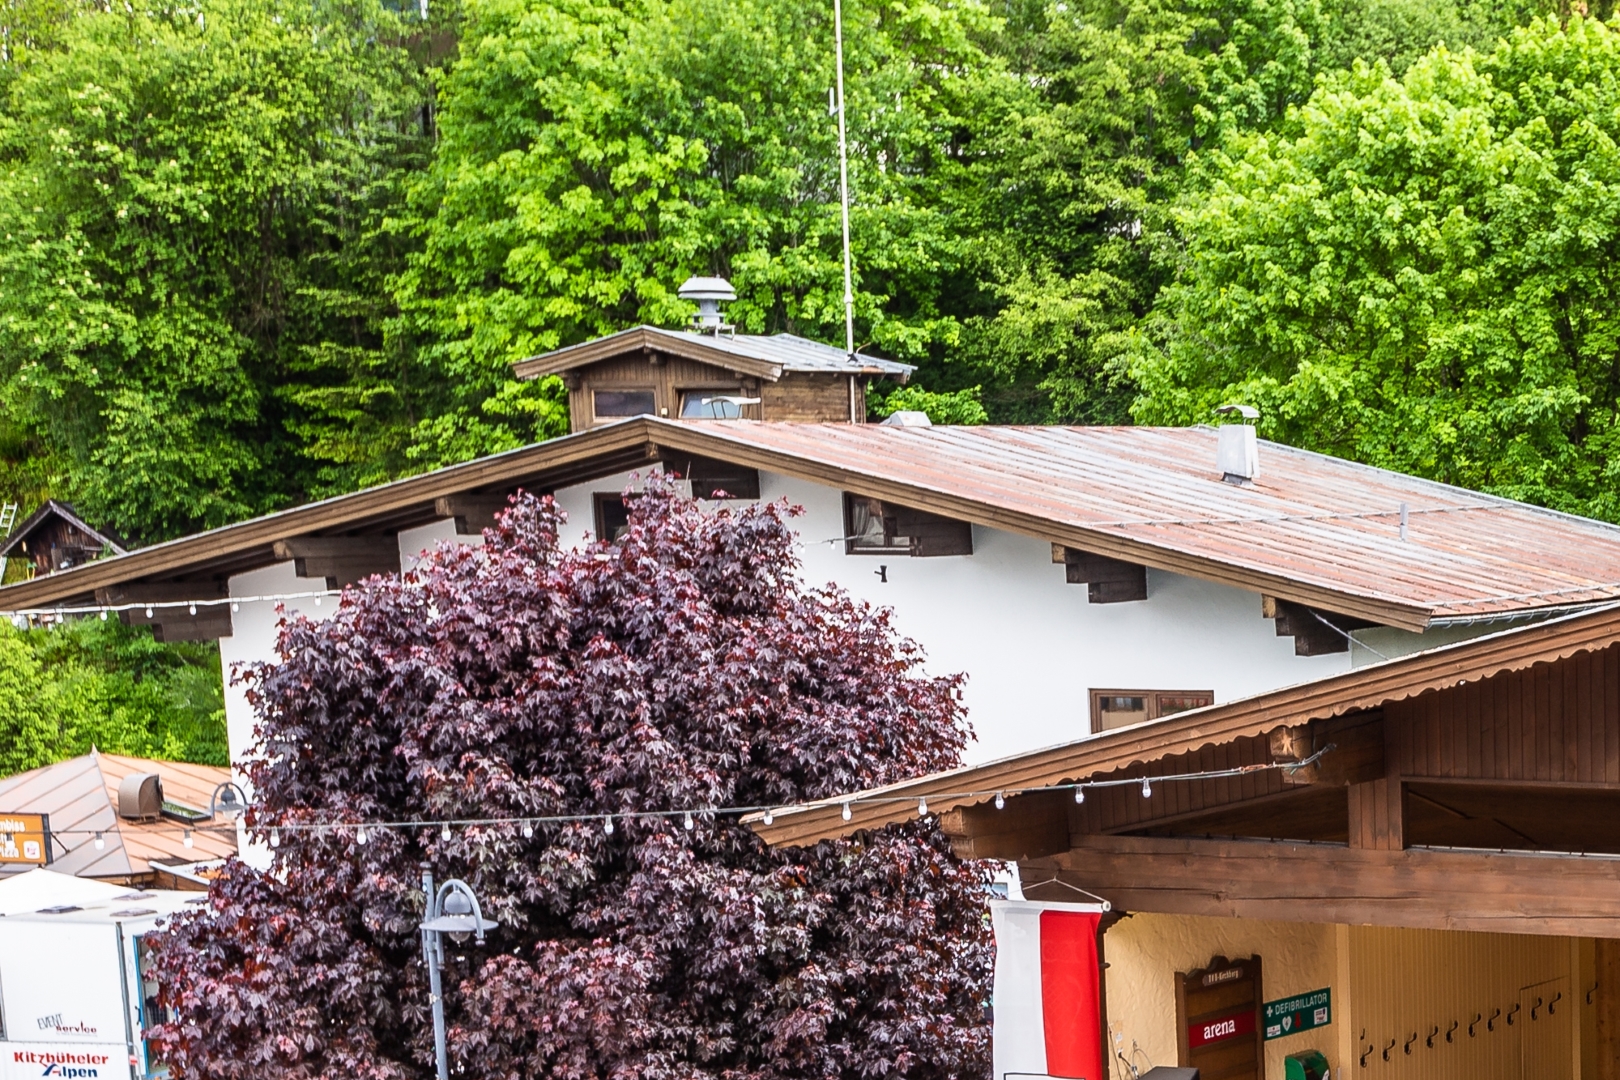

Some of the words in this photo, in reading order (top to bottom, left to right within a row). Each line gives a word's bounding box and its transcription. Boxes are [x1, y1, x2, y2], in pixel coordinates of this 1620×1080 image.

[1275, 992, 1328, 1016] DEFIBRILLATOR
[37, 1013, 63, 1030] EVENT
[56, 1020, 97, 1033] service
[1203, 1019, 1236, 1040] arena
[14, 1051, 109, 1068] Kitzbüheler
[42, 1063, 98, 1079] Alpen
